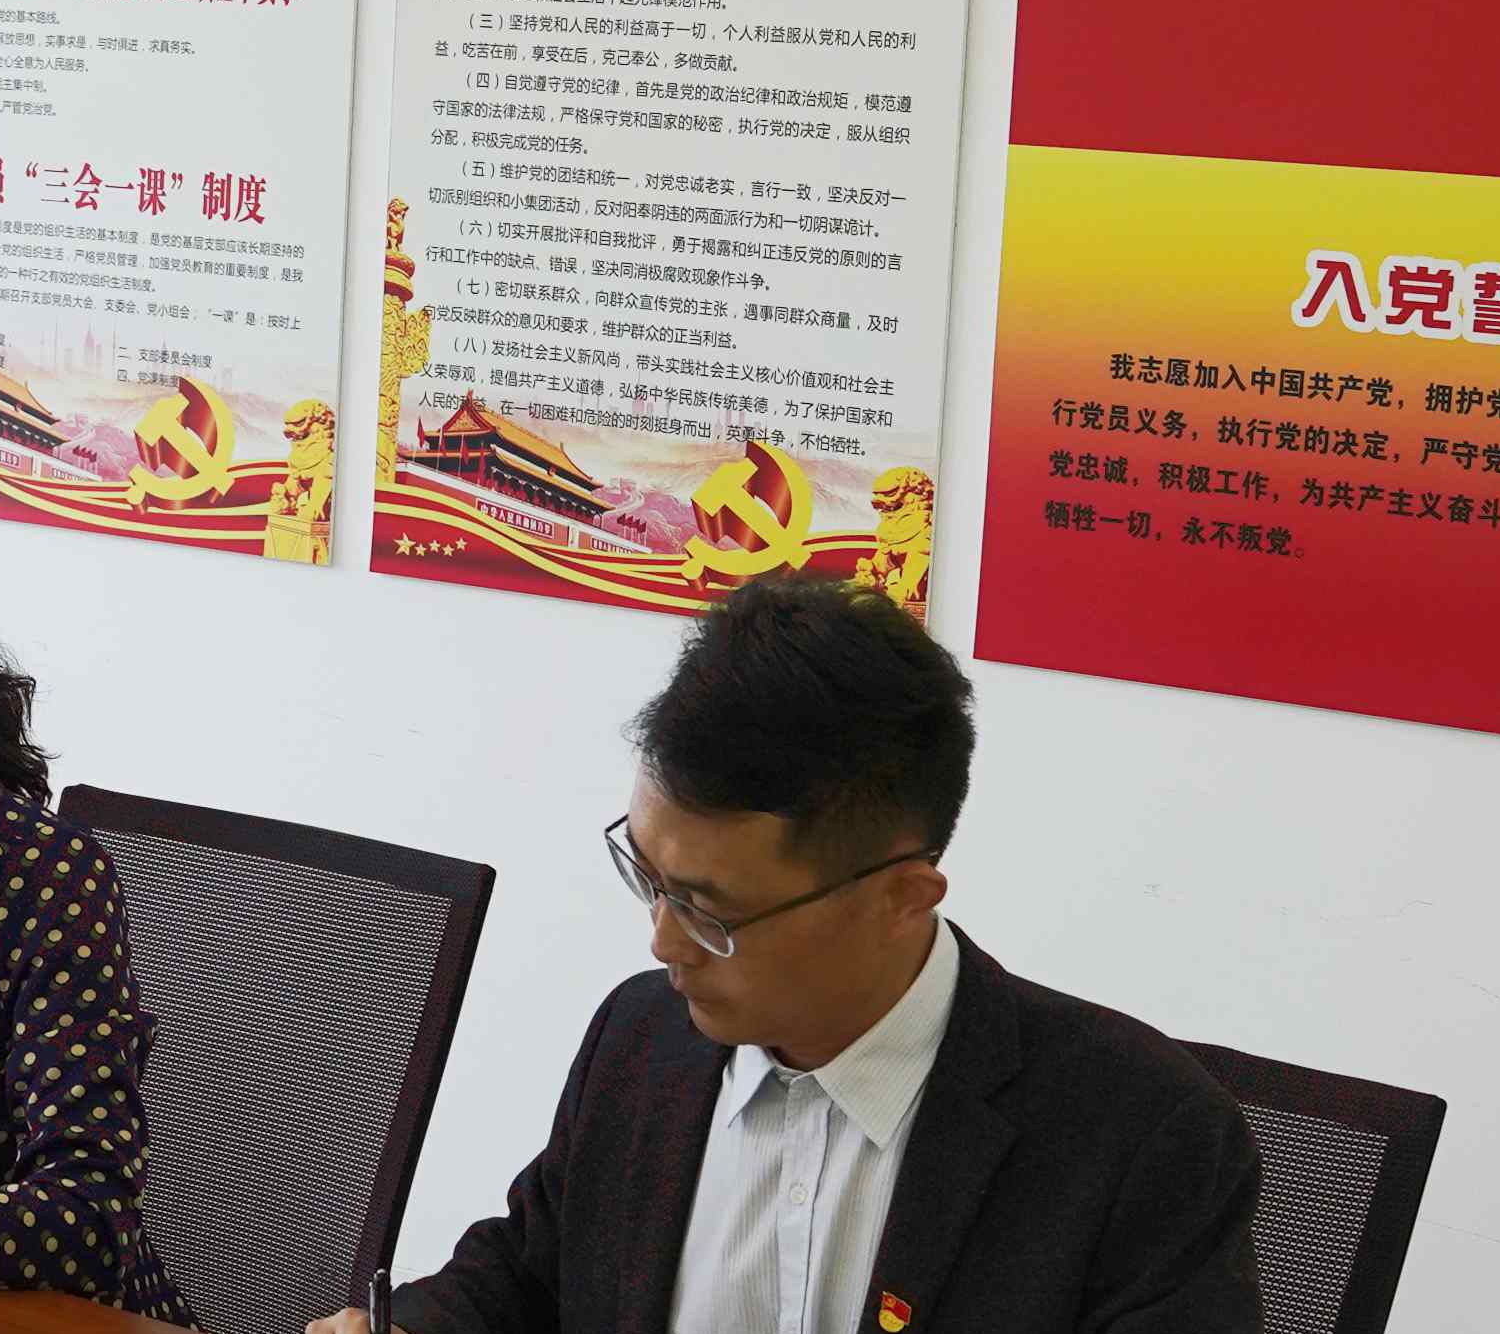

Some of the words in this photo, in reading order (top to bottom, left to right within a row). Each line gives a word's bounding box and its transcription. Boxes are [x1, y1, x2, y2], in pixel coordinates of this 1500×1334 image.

[1042, 500, 1307, 558] 牺牲一切，永不叛党。
